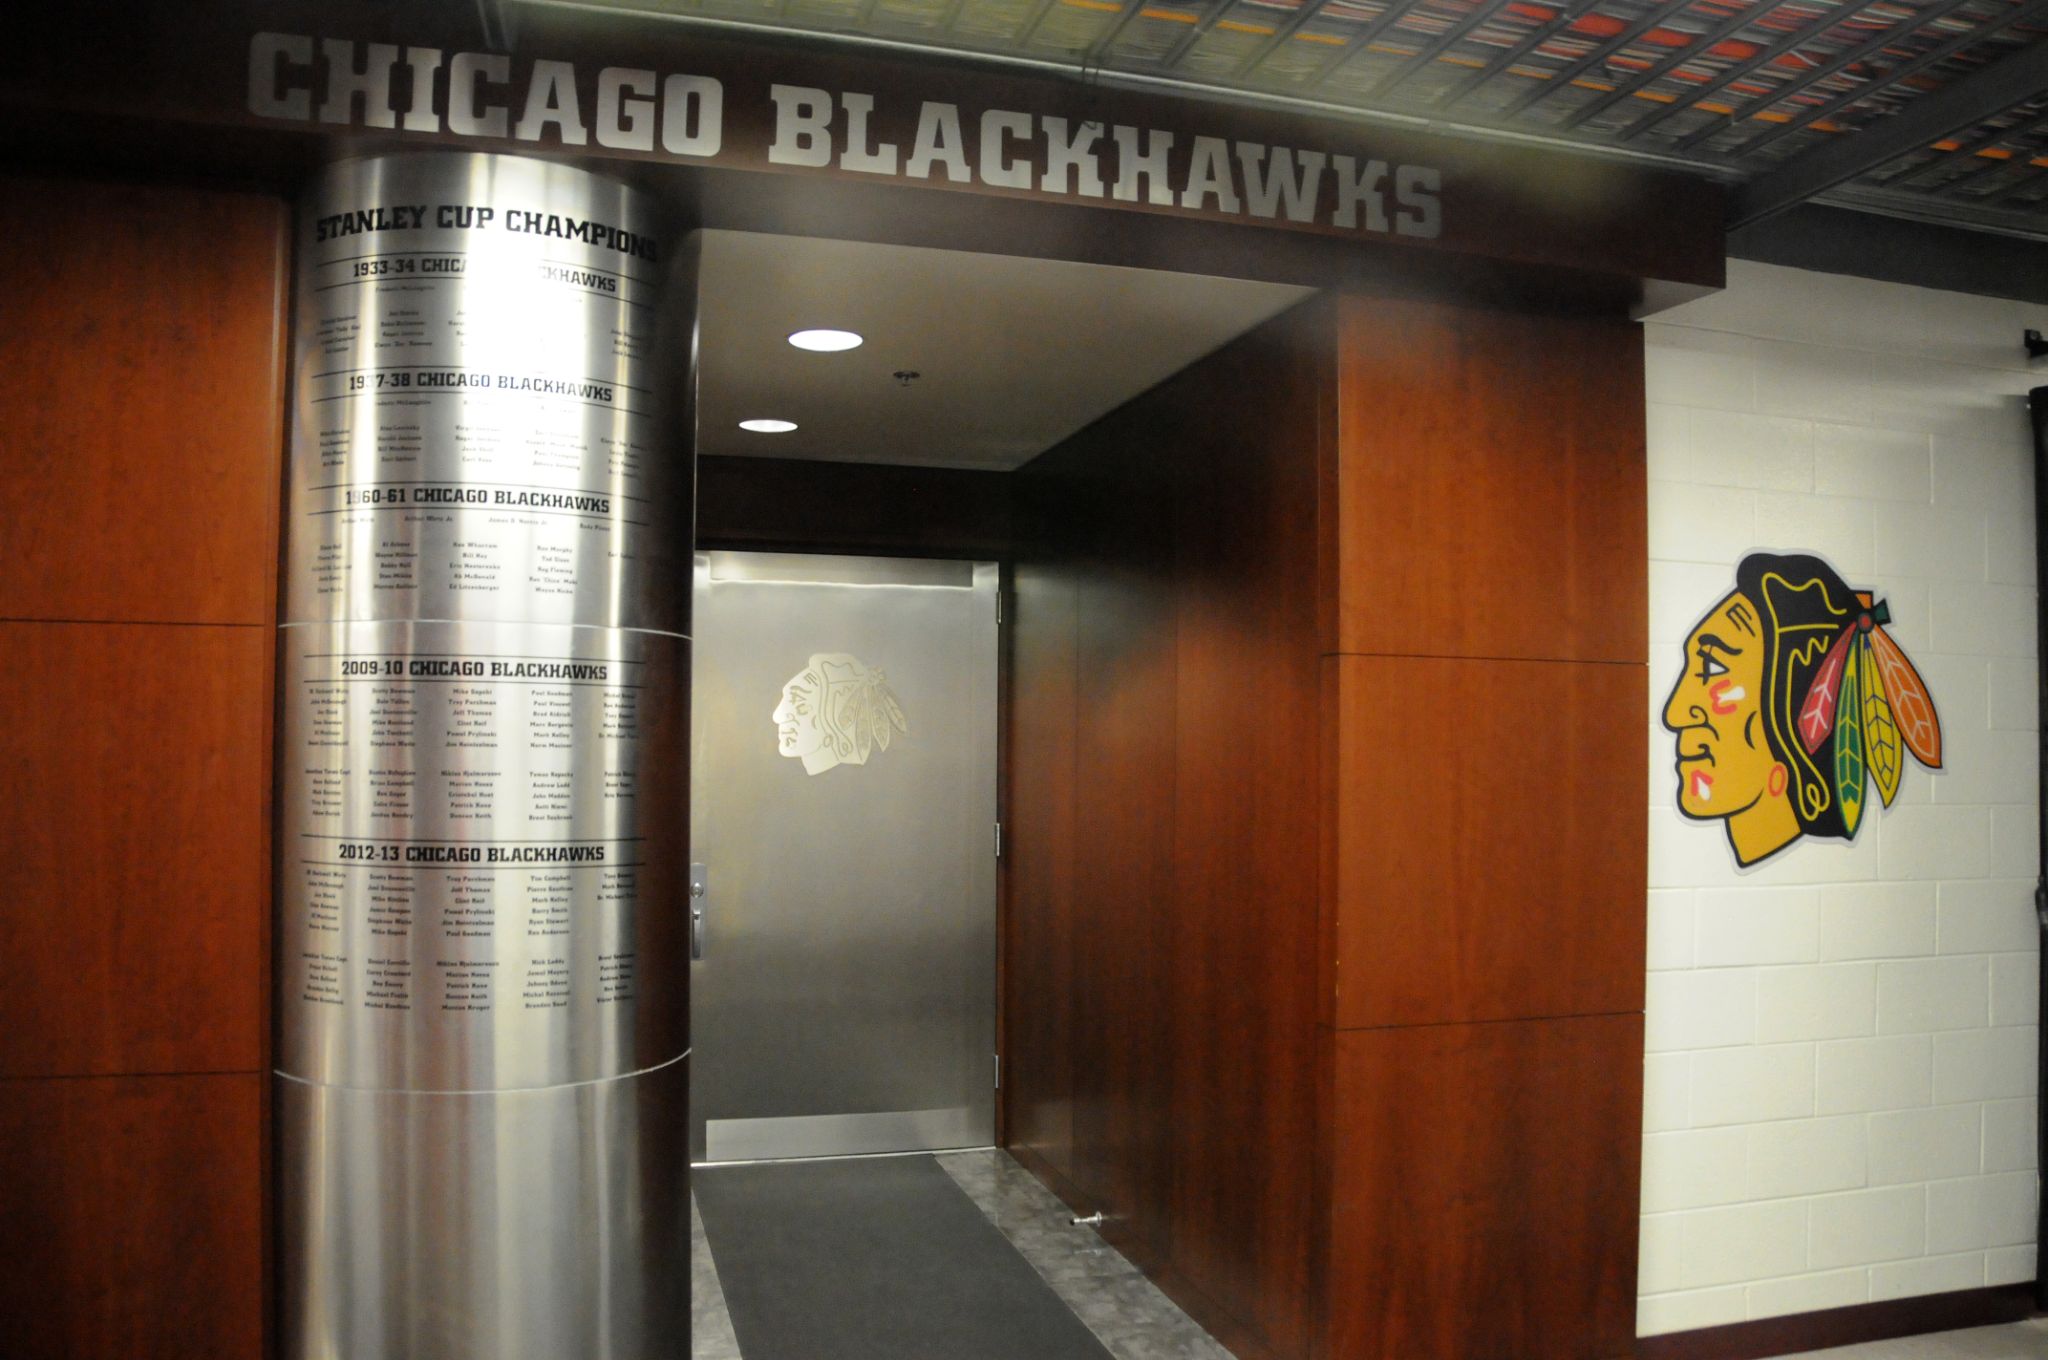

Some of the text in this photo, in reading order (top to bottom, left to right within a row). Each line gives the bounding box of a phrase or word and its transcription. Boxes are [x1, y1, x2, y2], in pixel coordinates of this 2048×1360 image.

[248, 32, 1442, 240] CHICAGO BLACKHAWKS
[316, 205, 658, 262] STANLEY CUP CHAMPIONS
[353, 259, 415, 277] 1933-34
[421, 258, 466, 272] CHIC
[349, 372, 613, 402] 197-38 CHICAGO BLACKHAWKS
[413, 488, 488, 503] CHICAGO
[494, 490, 610, 513] BLACKHAWKS
[342, 660, 607, 680] 2009-10 CHICAGO BLACKHAWKS
[339, 844, 605, 862] 2012-13 CHICAGO BLACKHAWKS
